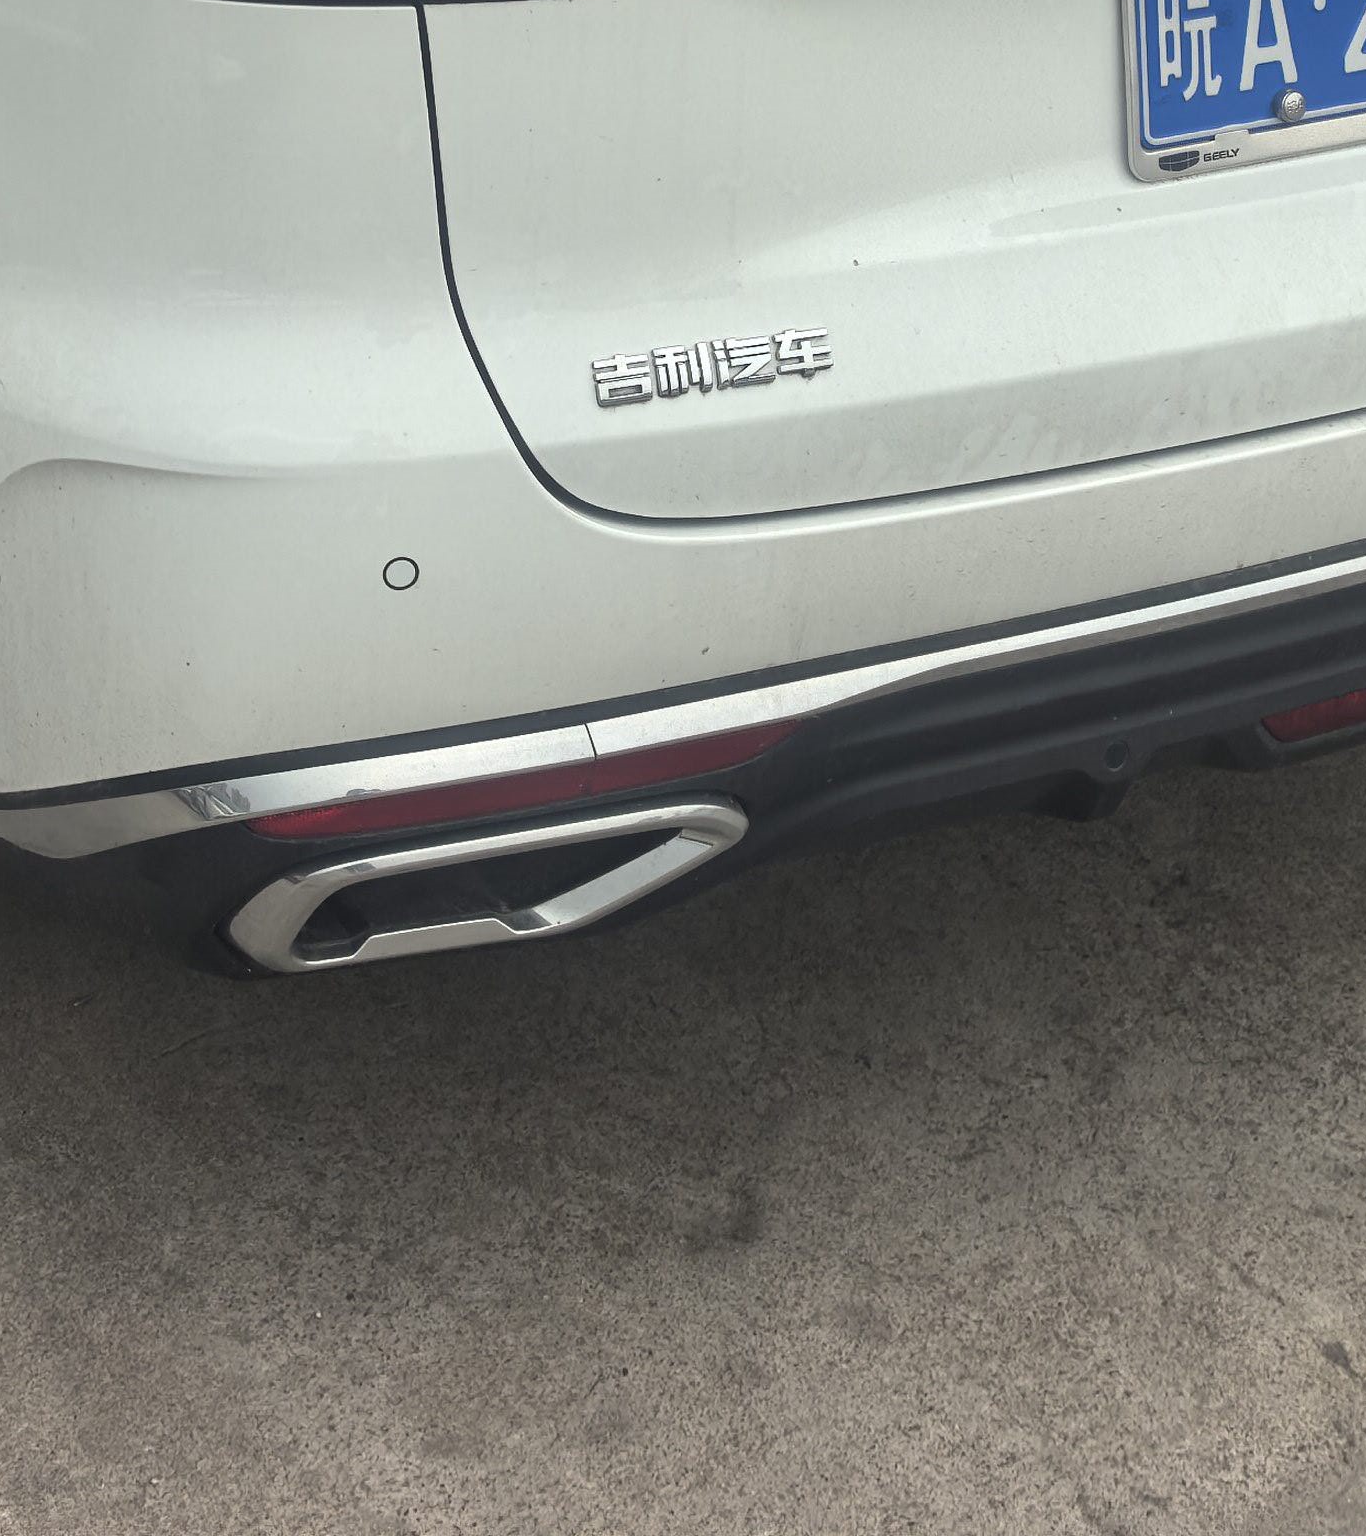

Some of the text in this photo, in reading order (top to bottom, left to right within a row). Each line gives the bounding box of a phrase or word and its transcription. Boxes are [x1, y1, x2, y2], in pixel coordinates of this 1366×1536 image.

[1202, 148, 1241, 163] GEELY
[591, 326, 834, 408] 吉利汽车
